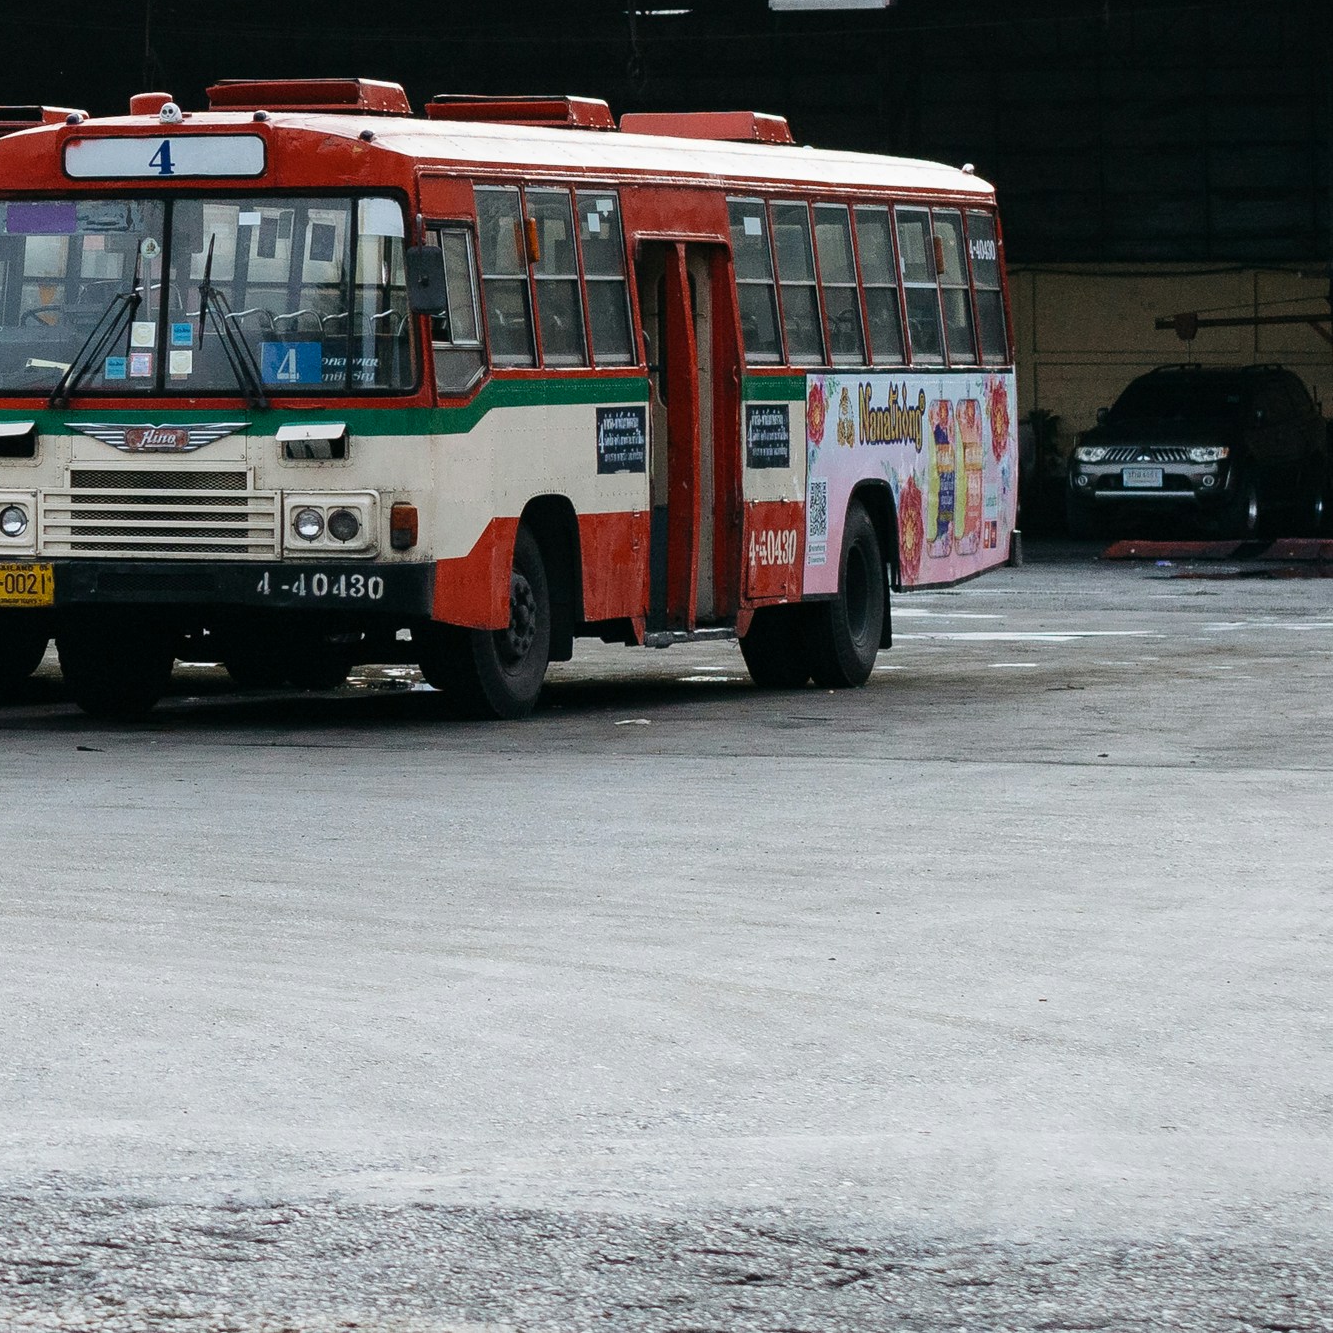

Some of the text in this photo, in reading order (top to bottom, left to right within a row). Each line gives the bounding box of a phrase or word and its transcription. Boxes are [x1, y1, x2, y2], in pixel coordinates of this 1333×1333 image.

[149, 140, 175, 174] 4
[276, 348, 300, 382] 4
[137, 429, 177, 447] Hino
[748, 529, 797, 566] 4-40430
